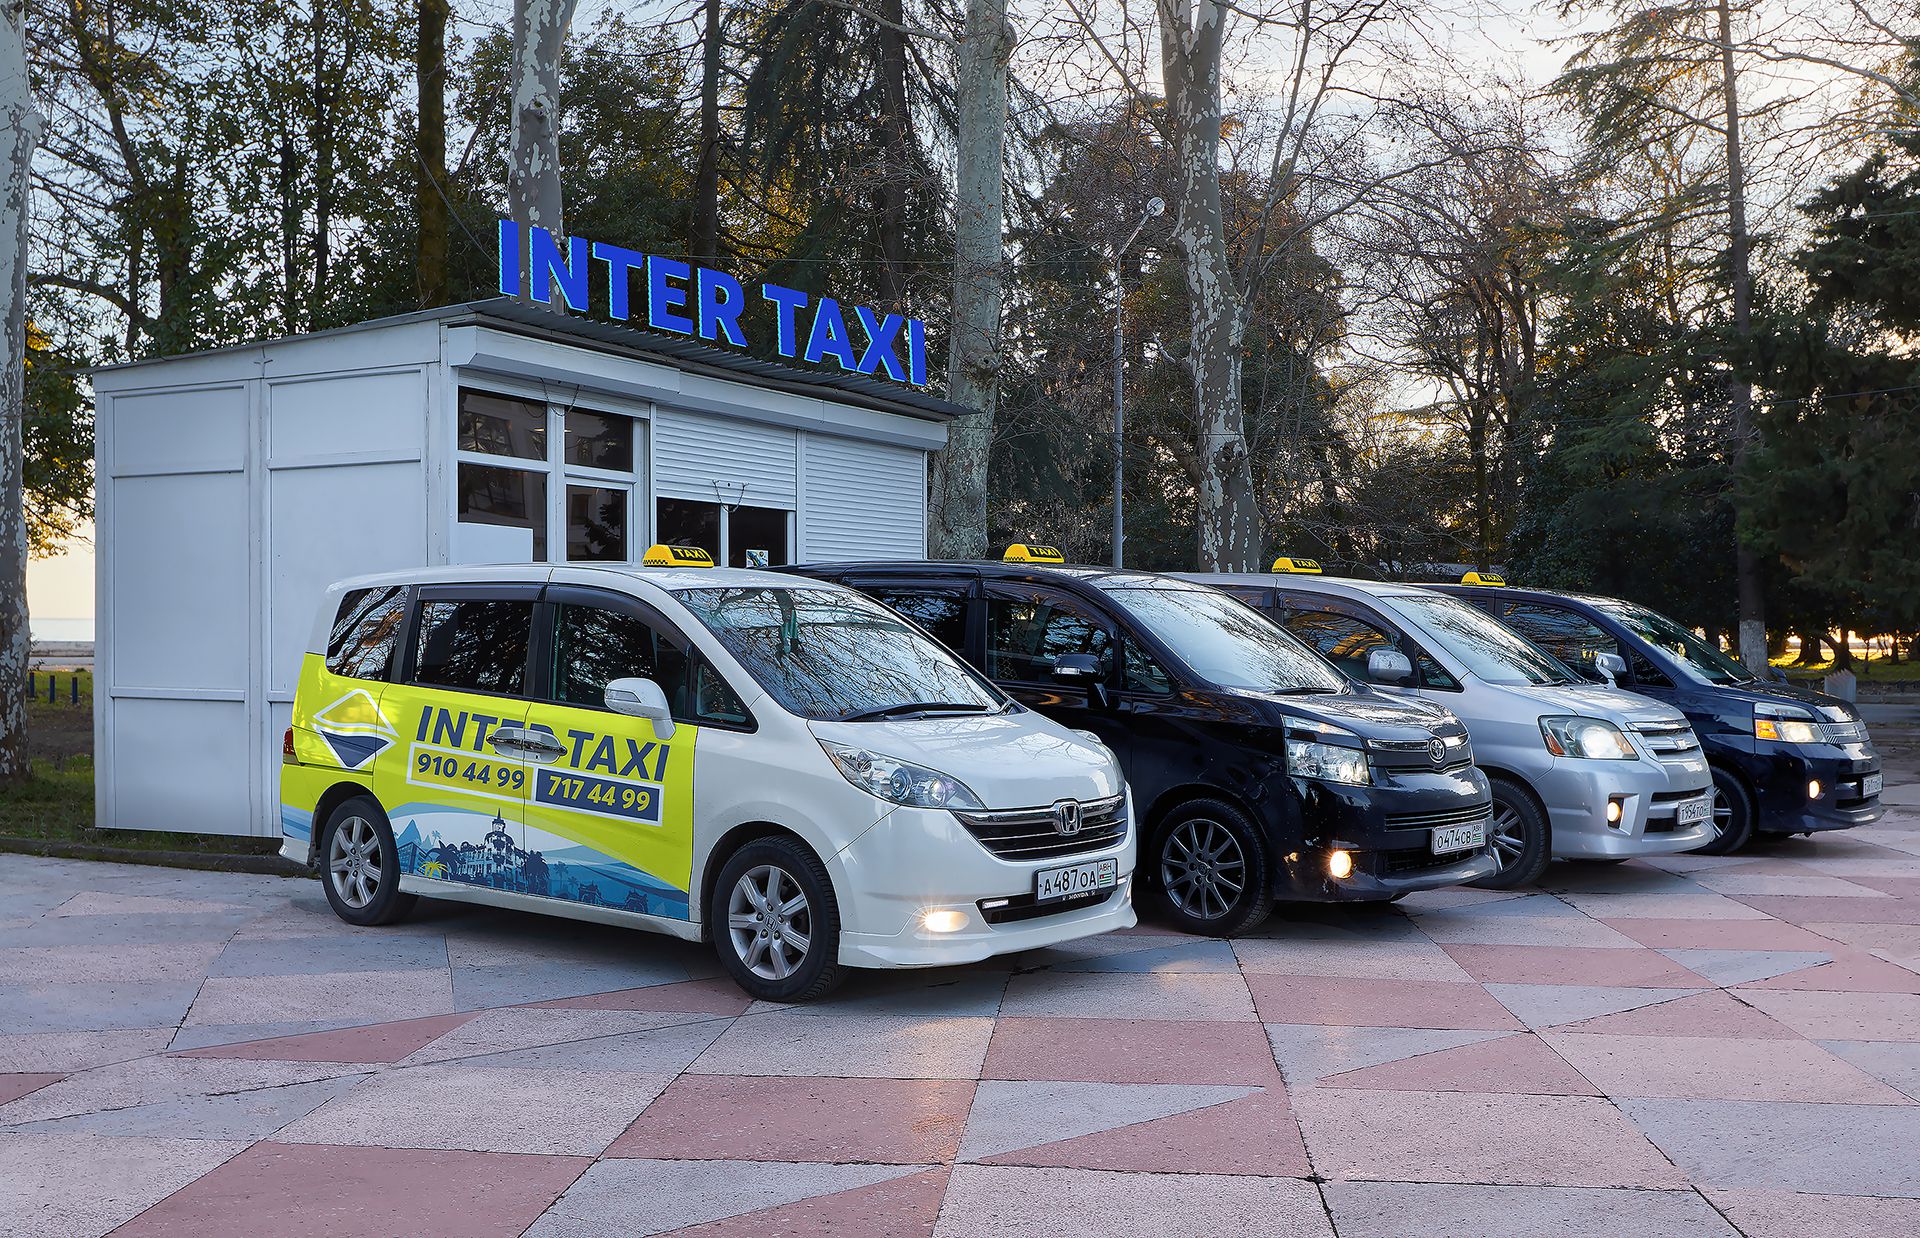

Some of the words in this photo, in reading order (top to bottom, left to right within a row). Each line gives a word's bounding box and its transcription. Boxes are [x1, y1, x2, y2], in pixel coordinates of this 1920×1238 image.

[498, 219, 748, 347] INTER
[762, 283, 927, 386] TAXI
[673, 547, 706, 559] TAXI
[1029, 547, 1058, 557] TAXI
[1293, 559, 1317, 568] TAXI
[416, 705, 555, 755] INT
[567, 729, 670, 782] TAXI
[417, 753, 458, 778] 910
[462, 762, 490, 785] 44
[496, 767, 525, 790] 99
[548, 775, 584, 801] 717
[587, 784, 615, 807] 44
[621, 788, 650, 812] 99
